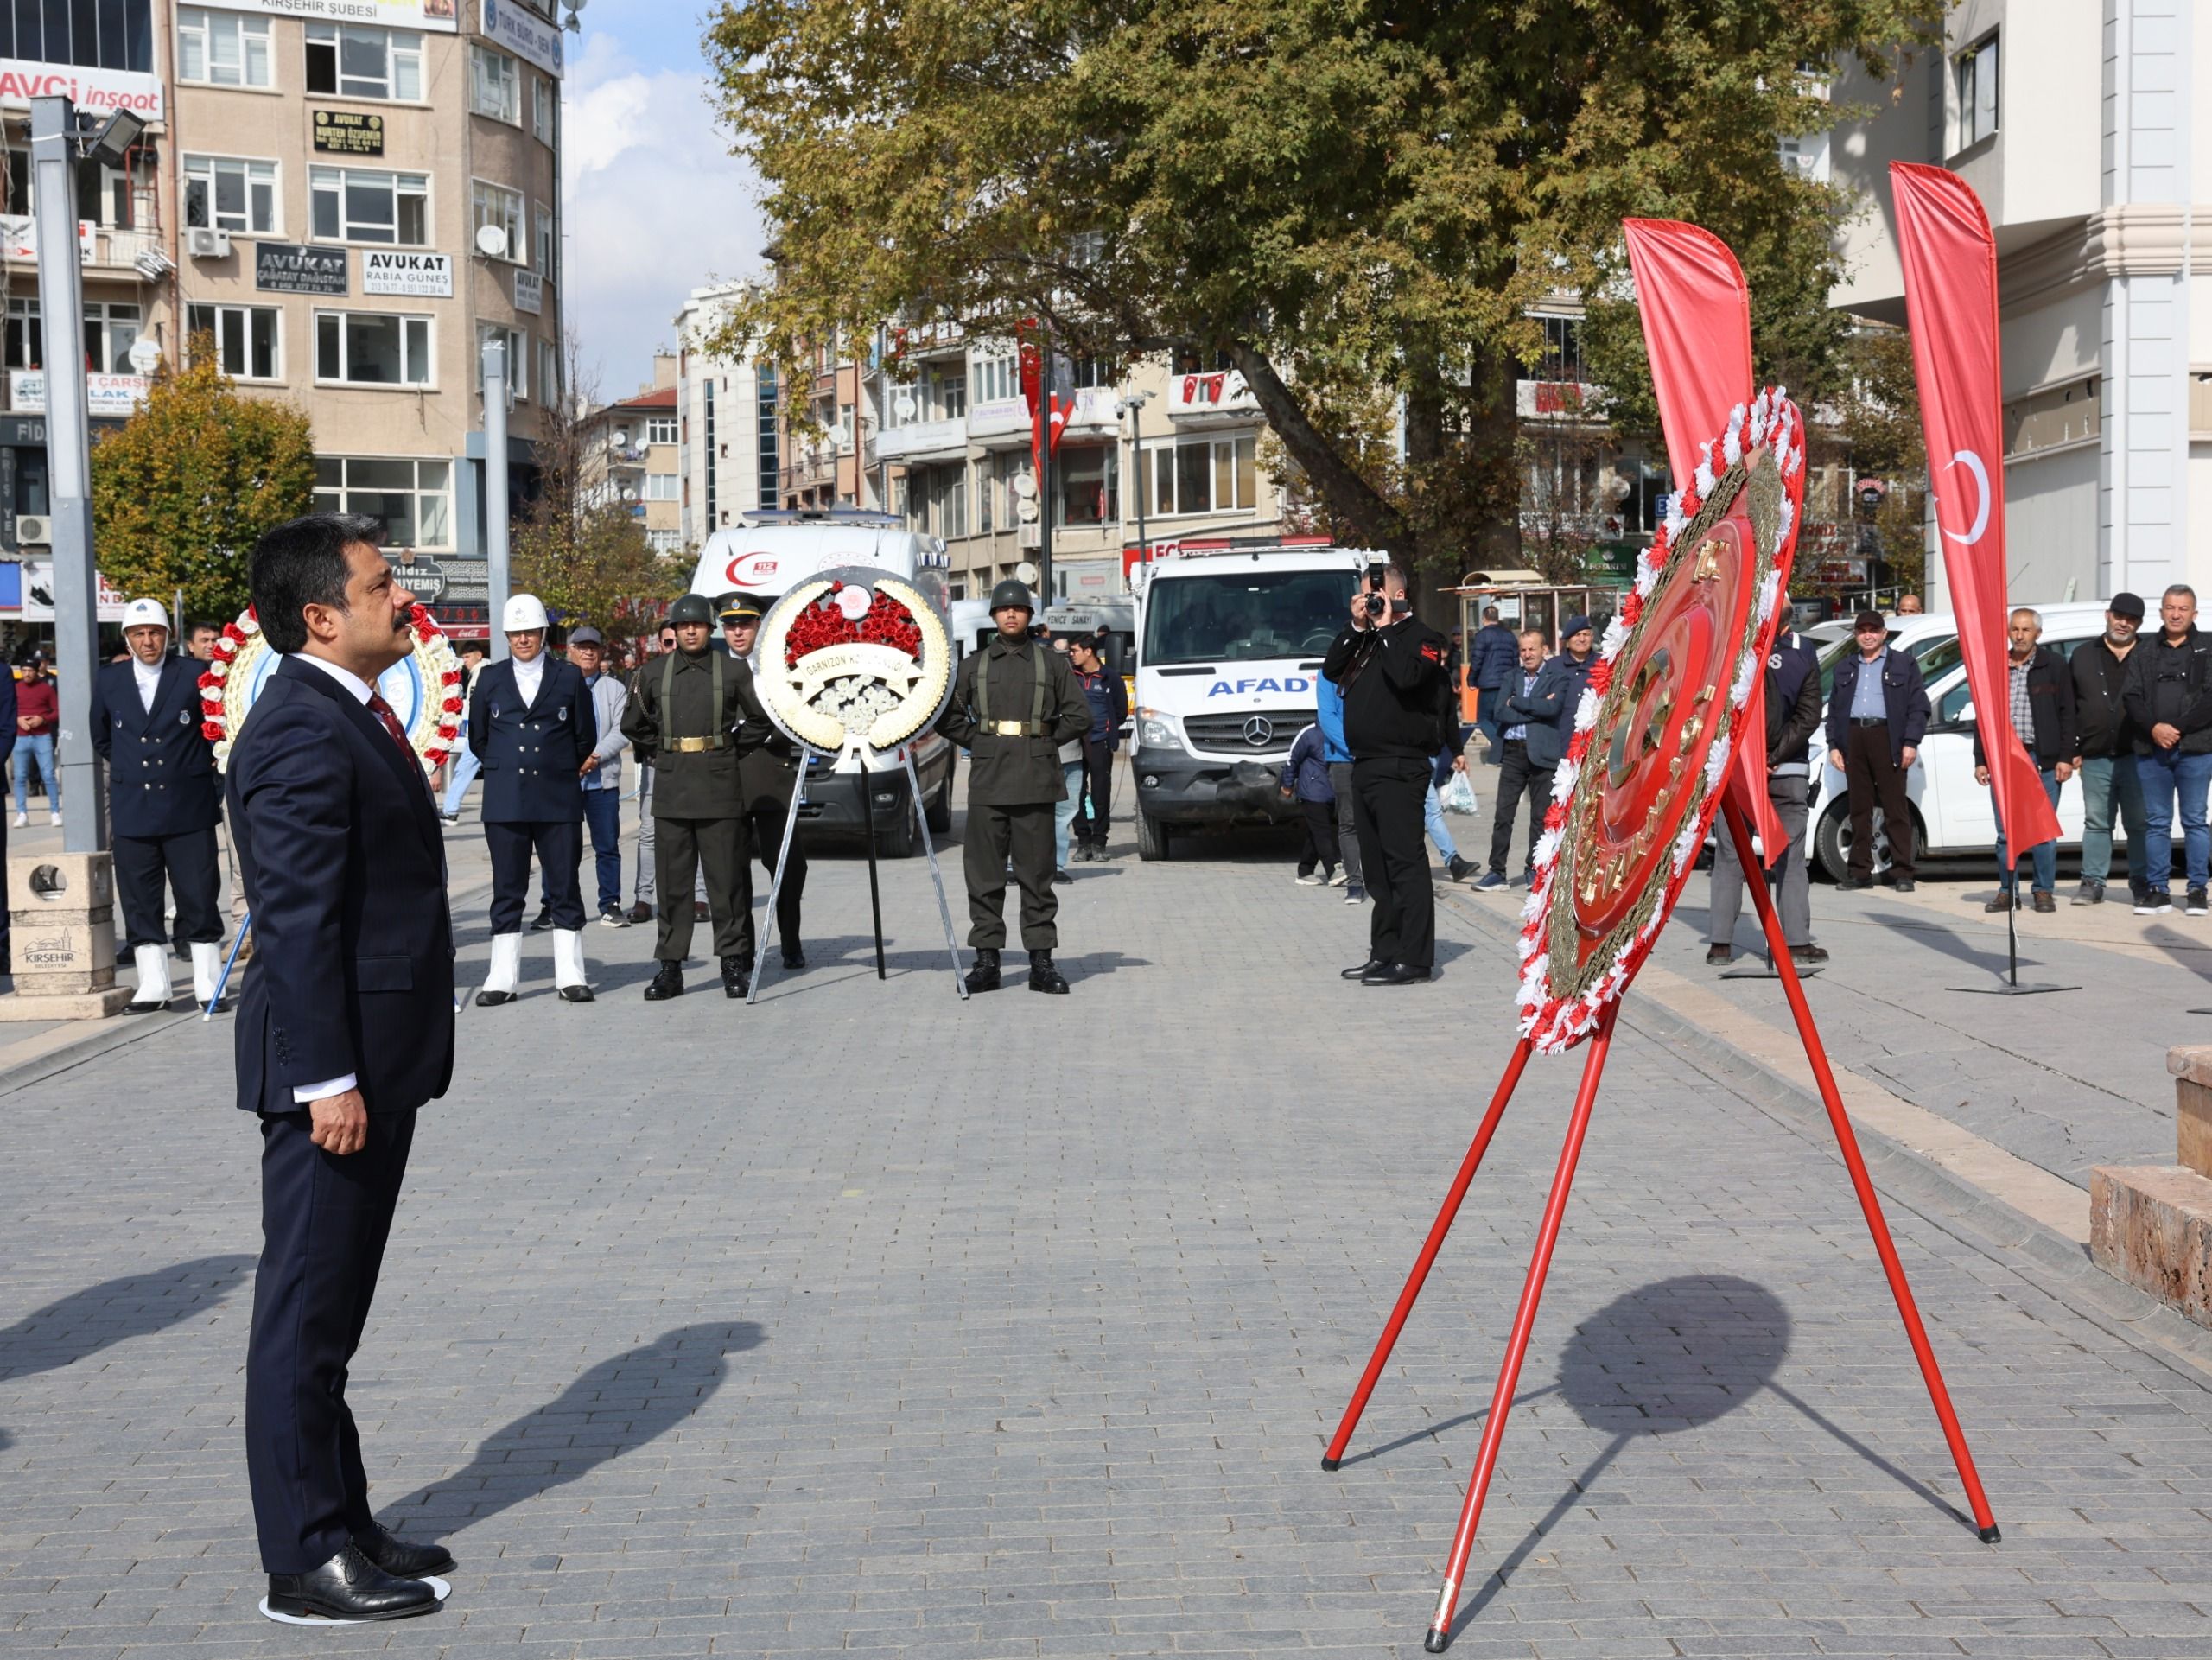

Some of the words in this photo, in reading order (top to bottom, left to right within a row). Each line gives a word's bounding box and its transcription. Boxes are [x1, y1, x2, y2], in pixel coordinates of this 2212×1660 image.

[329, 3, 378, 17] ŞUBESİ
[537, 35, 550, 55] SEN
[86, 85, 159, 111] inşaat
[334, 113, 363, 126] AVUKAT
[261, 253, 344, 273] AVUKAT
[370, 254, 444, 271] AVUKAT
[366, 271, 402, 282] RABİA
[407, 271, 448, 286] GÜNEŞ
[90, 390, 129, 398] LAK
[757, 562, 775, 570] 112
[1047, 614, 1067, 625] YENİCE
[1072, 613, 1092, 625] SANAYİ
[1207, 677, 1309, 697] AFAD
